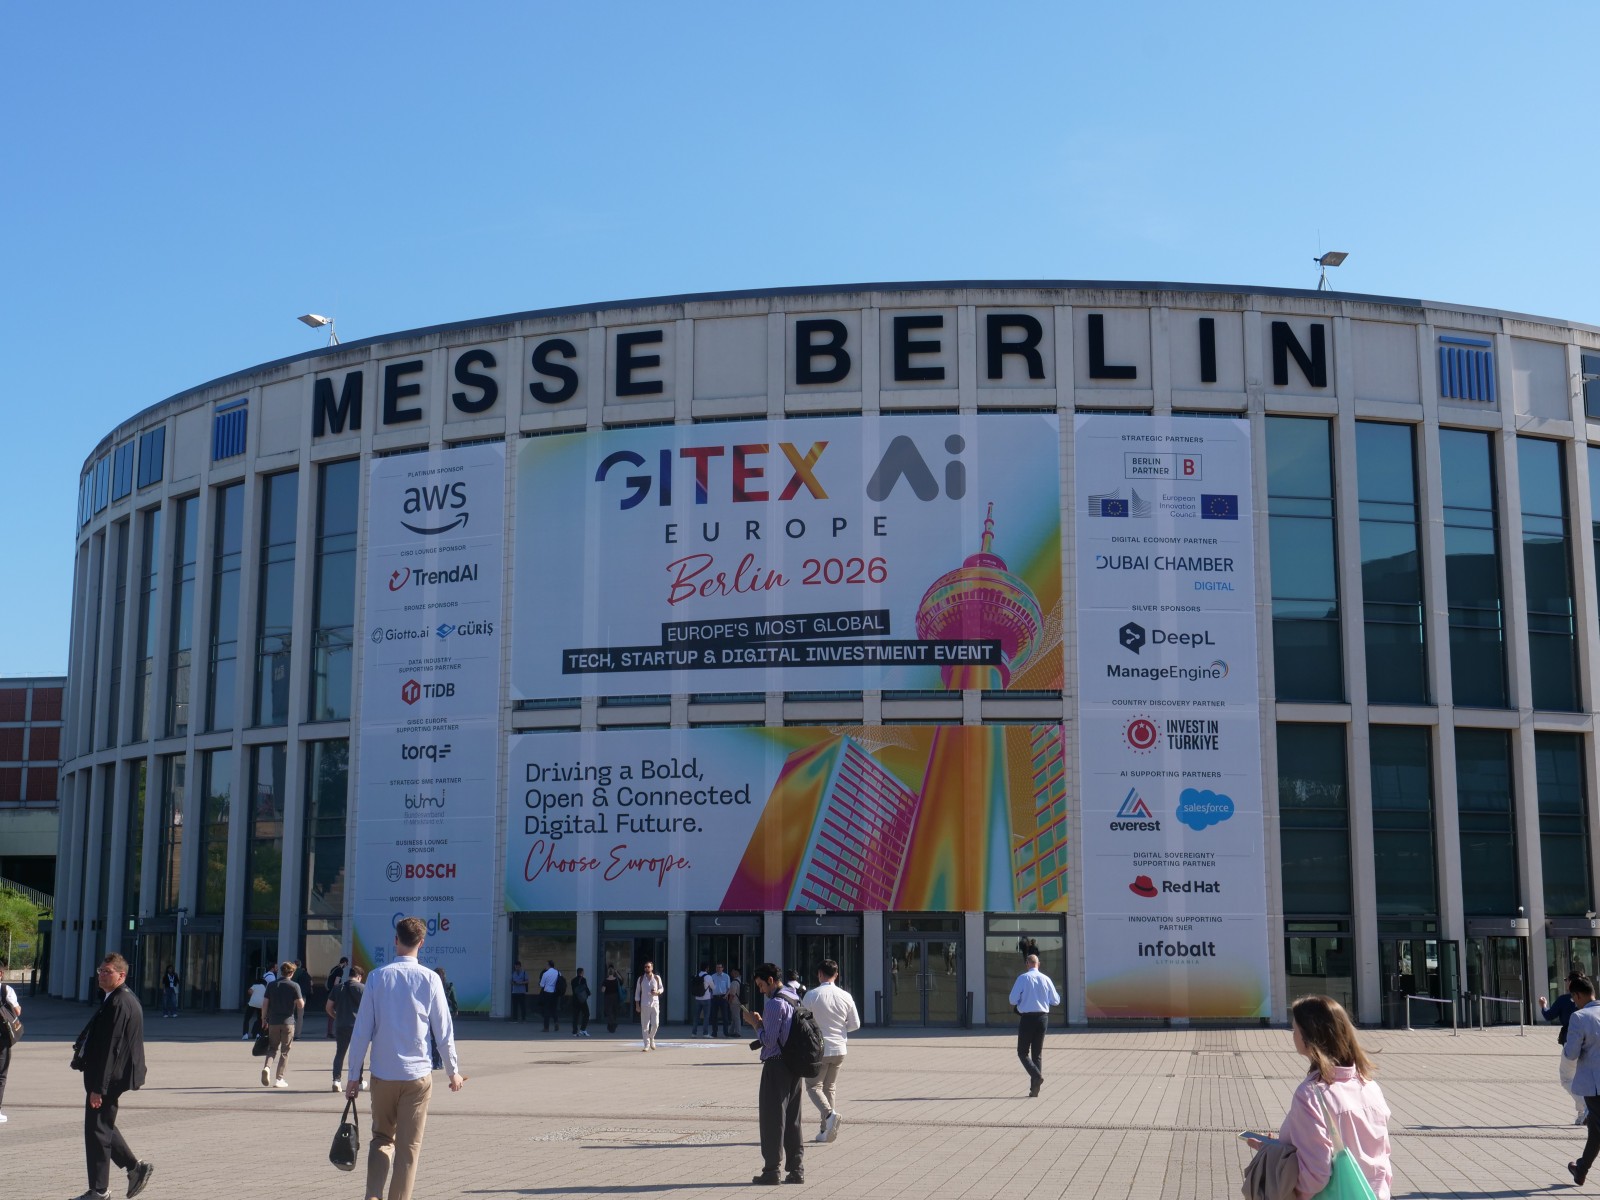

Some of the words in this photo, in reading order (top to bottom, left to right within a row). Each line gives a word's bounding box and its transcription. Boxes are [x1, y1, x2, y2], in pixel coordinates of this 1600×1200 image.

[313, 330, 663, 437] MESSE
[796, 314, 1327, 387] BERLIN
[437, 466, 464, 474] SPONSOR
[1184, 459, 1194, 475] B
[595, 441, 829, 510] GITEX
[404, 482, 466, 513] aws
[1163, 494, 1195, 502] European
[665, 516, 887, 543] EUROPE
[1096, 555, 1148, 570] DUBAI
[1154, 556, 1234, 572] CHAMBER
[413, 564, 477, 586] TrendAI
[666, 553, 790, 606] Berlin
[802, 557, 887, 585] 2026
[1195, 582, 1235, 591] DIGITAL
[386, 626, 429, 640] Giotto.ai
[668, 624, 749, 641] EUROPE'S
[755, 619, 806, 636] MOST
[814, 616, 884, 633] GLOBAL
[1152, 630, 1215, 648] DeepL
[569, 652, 616, 669] TECH,
[621, 650, 698, 667] STARTUP
[703, 649, 717, 664] &
[722, 647, 800, 663] DIGITAL
[806, 645, 928, 662] INVESTMENT
[934, 644, 993, 660] EVENT
[1107, 665, 1220, 681] ManageEngine
[423, 683, 455, 698] TiDB
[1167, 720, 1205, 733] INVEST
[1208, 720, 1218, 734] IN
[526, 762, 612, 786] Driving
[620, 766, 633, 779] a
[641, 758, 704, 782] Bold,
[525, 789, 583, 813] Open
[592, 787, 609, 807] &
[617, 784, 751, 807] Connected
[1184, 803, 1229, 814] salesforce
[525, 813, 608, 840] Digital
[616, 813, 702, 833] Future.
[1110, 821, 1160, 831] everest
[405, 864, 456, 878] BOSCH
[524, 840, 600, 882] Choose
[604, 844, 691, 887] Europe.
[1162, 880, 1192, 893] Red
[1194, 881, 1220, 893] Hat
[1511, 920, 1516, 928] B
[1591, 920, 1595, 928] B
[436, 946, 466, 954] ESTONIA
[1138, 941, 1216, 957] infobalt
